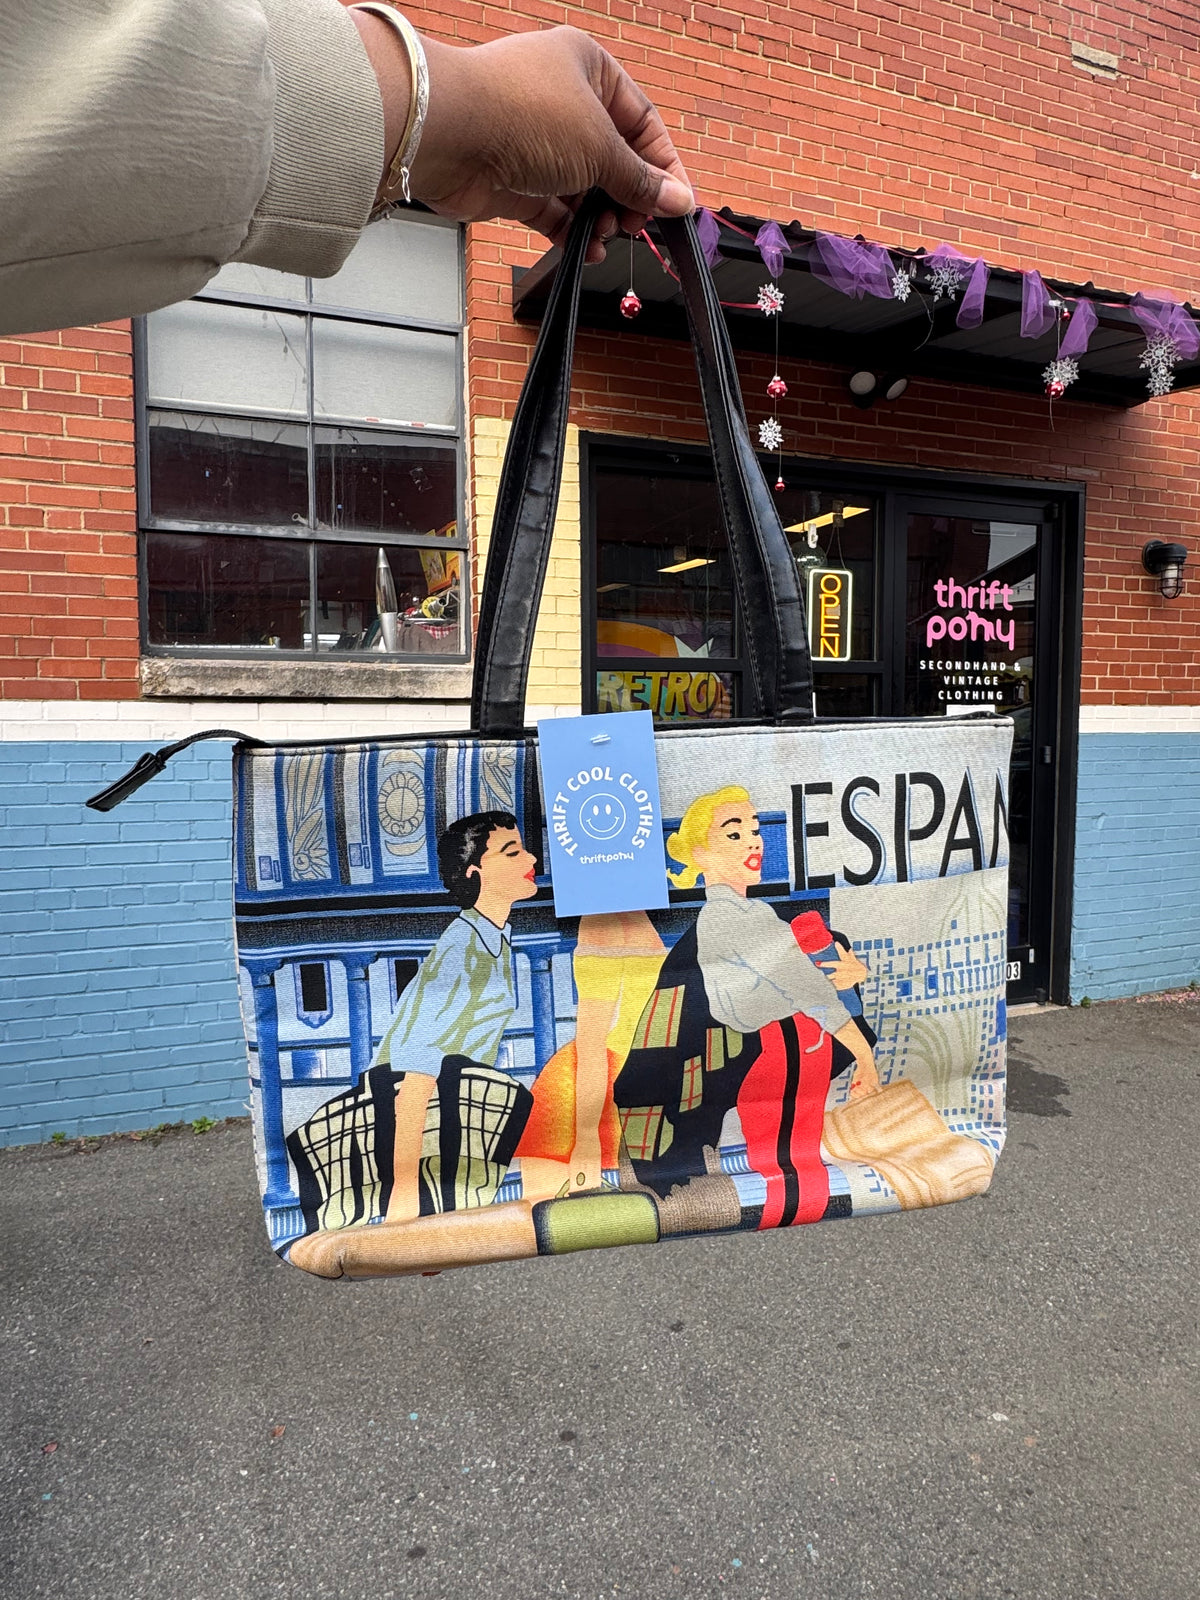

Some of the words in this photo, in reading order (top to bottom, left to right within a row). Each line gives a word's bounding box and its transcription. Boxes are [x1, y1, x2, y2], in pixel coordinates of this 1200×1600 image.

[933, 577, 1014, 611] thrift
[820, 574, 842, 658] OPEN
[926, 610, 1015, 651] pony
[919, 660, 1006, 671] SECONDHAND
[1013, 661, 1021, 672] &
[943, 675, 999, 686] VINTAGE
[598, 671, 719, 714] RETRO
[938, 690, 1003, 700] CLOTHING
[552, 791, 579, 857] THRIFT
[566, 766, 614, 792] COOL
[619, 772, 654, 849] CLOTHES
[579, 851, 634, 865] thriftpony
